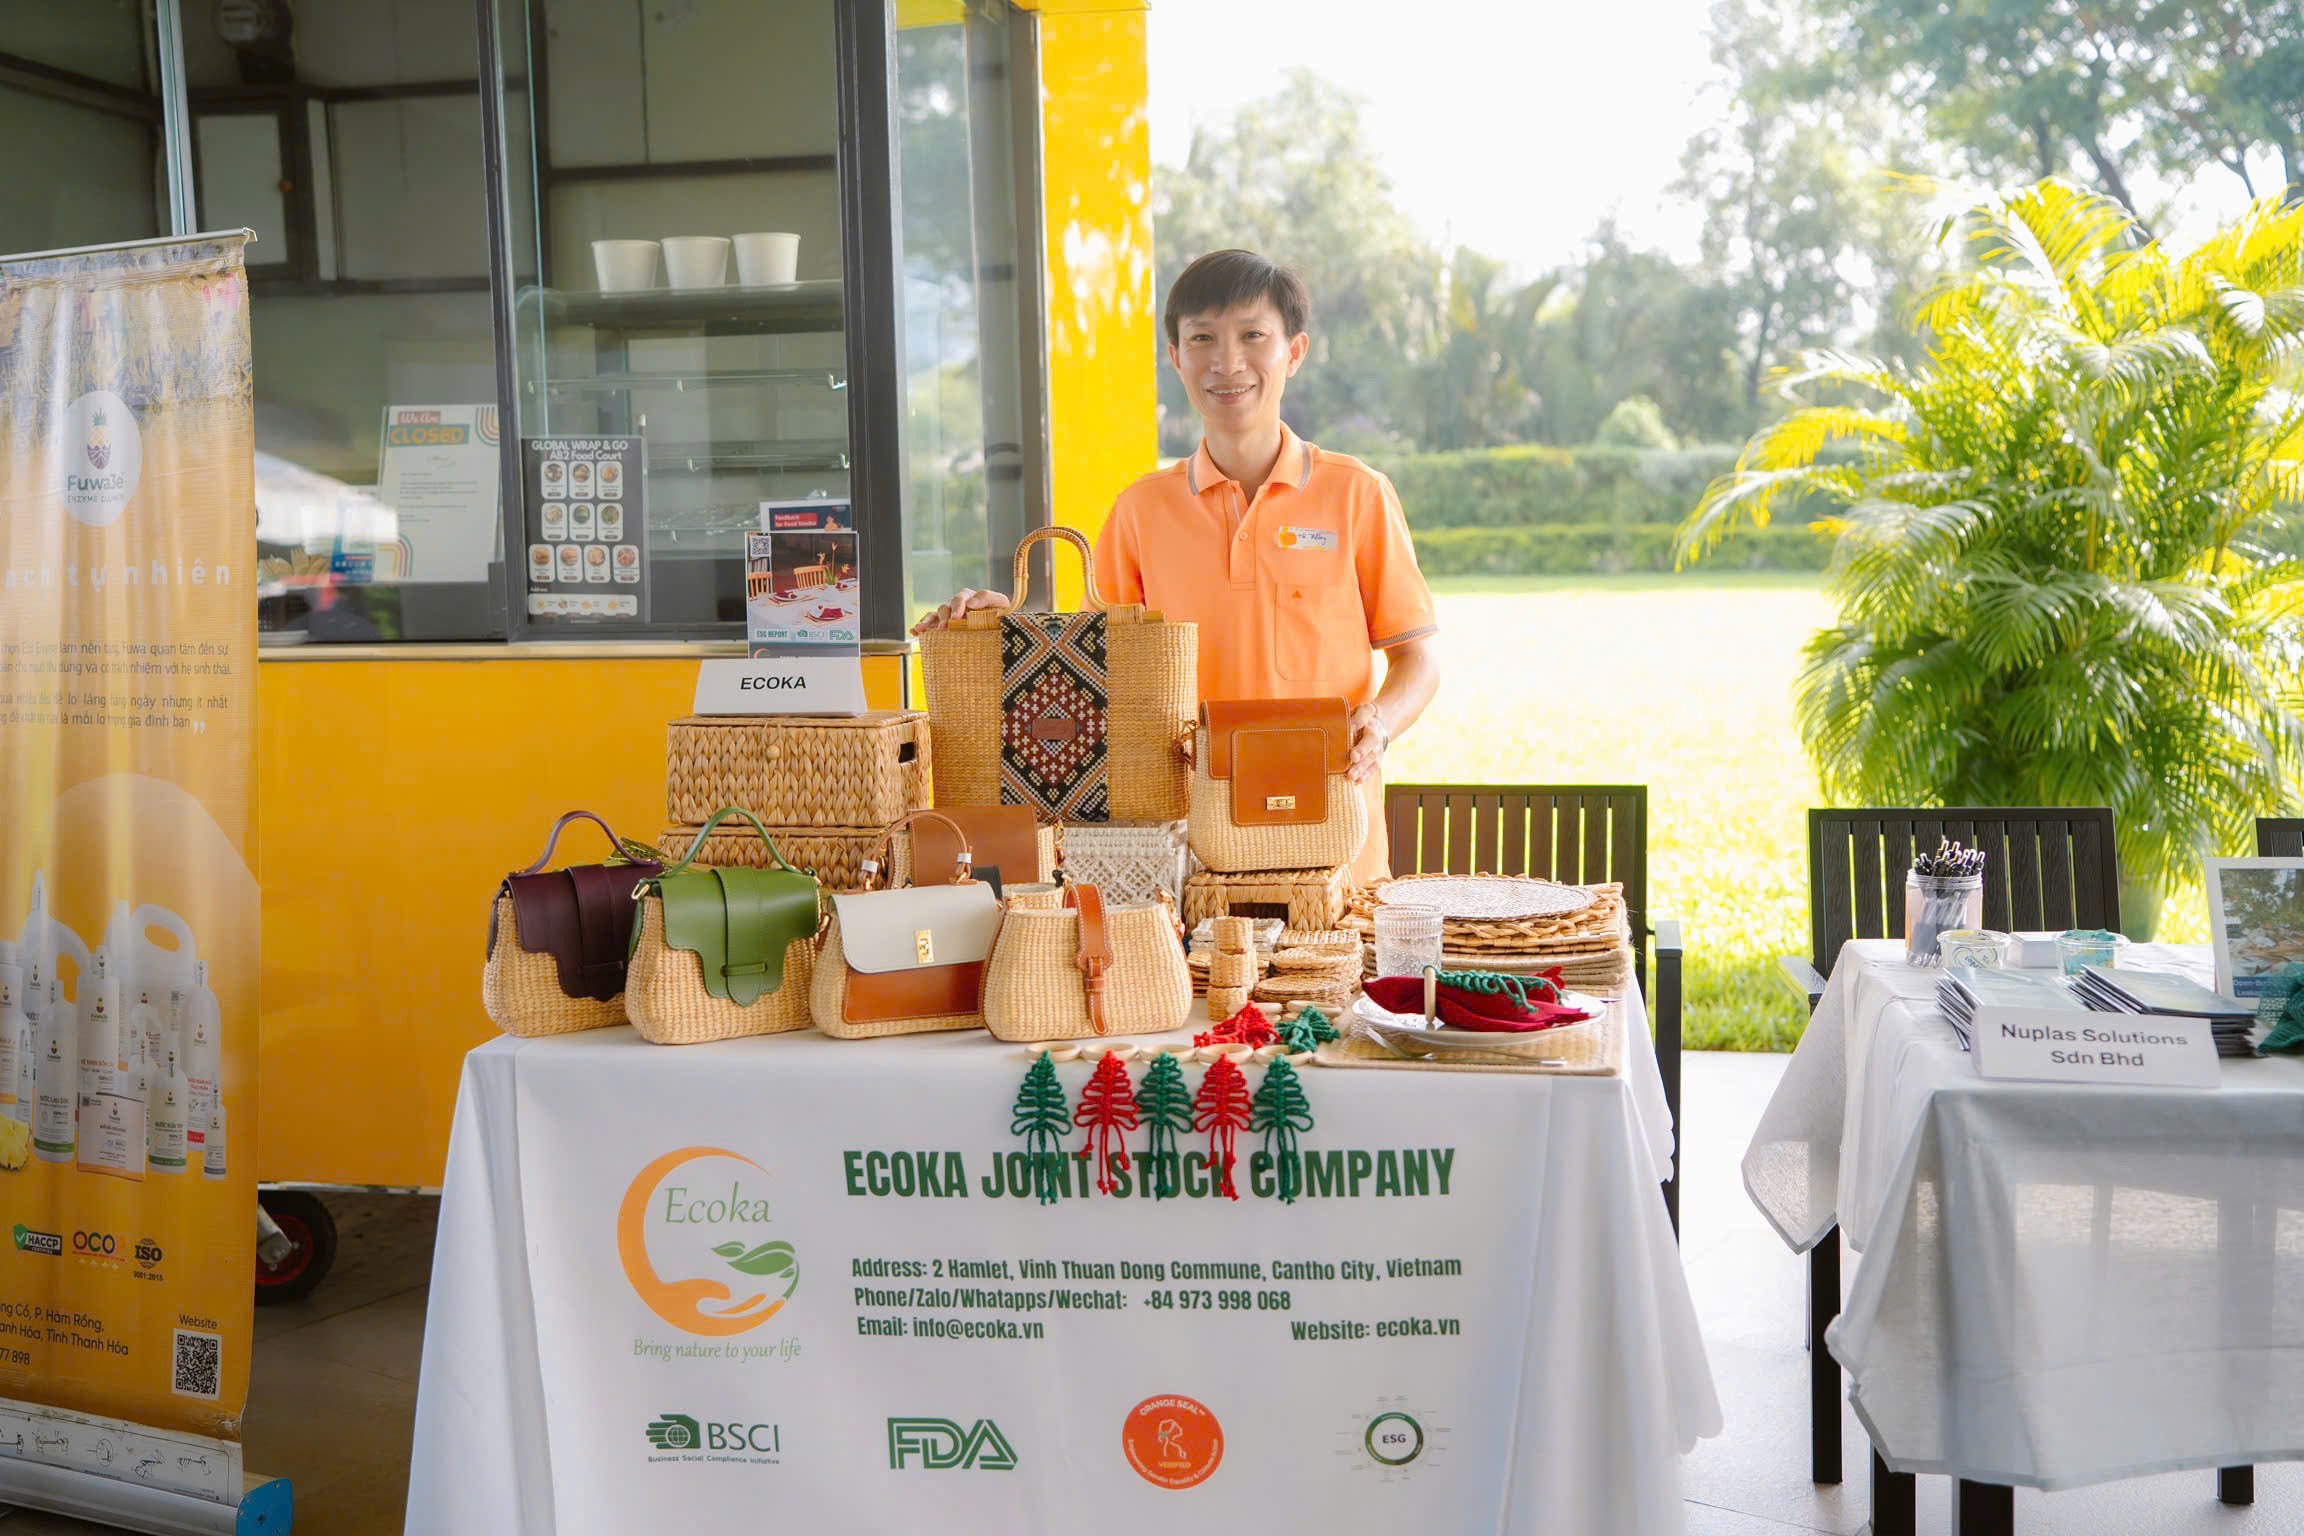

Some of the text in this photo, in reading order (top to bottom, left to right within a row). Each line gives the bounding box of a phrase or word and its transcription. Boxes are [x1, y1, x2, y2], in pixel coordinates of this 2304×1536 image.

[390, 427, 465, 444] CLOSED
[531, 440, 629, 451] GLOBAL WRAP & GO
[549, 450, 622, 460] AB2 Food Court
[768, 630, 788, 638] REPORT
[829, 630, 855, 640] FDA
[740, 676, 806, 690] ECOKA
[2001, 1024, 2188, 1045] Nuplas Solutions
[2051, 1050, 2144, 1066] Sdn Bhd
[844, 1150, 968, 1198] ECOKA
[981, 1150, 1092, 1198] JOINT
[1250, 1148, 1455, 1198] COMPANY
[664, 1181, 772, 1223] Ecoka
[28, 1233, 59, 1250] HACCP
[73, 1230, 126, 1255] OCO
[134, 1244, 163, 1262] ISO
[852, 1258, 1462, 1282] Address: 2 Hamlet, Vinh Thuan Dong Commune, Cantho City, Vietnam
[854, 1287, 1292, 1311] Phone/Zalo/Whatapps/Wechat: +84 973 998 068
[179, 1313, 218, 1330] Website
[857, 1316, 1045, 1339] Email: info@ecoka.vn
[1291, 1317, 1461, 1341] Website: ecoka.vn
[71, 1332, 104, 1352] Thanh
[633, 1337, 802, 1364] Bring nature to your life
[12, 1350, 31, 1366] 898
[1139, 1399, 1176, 1416] ORANGE
[707, 1423, 780, 1453] BSCI
[887, 1416, 1019, 1471] FDA
[1382, 1433, 1407, 1444] ESG
[648, 1455, 680, 1463] Business
[706, 1455, 747, 1463] Compliance
[750, 1457, 780, 1465] Initiative
